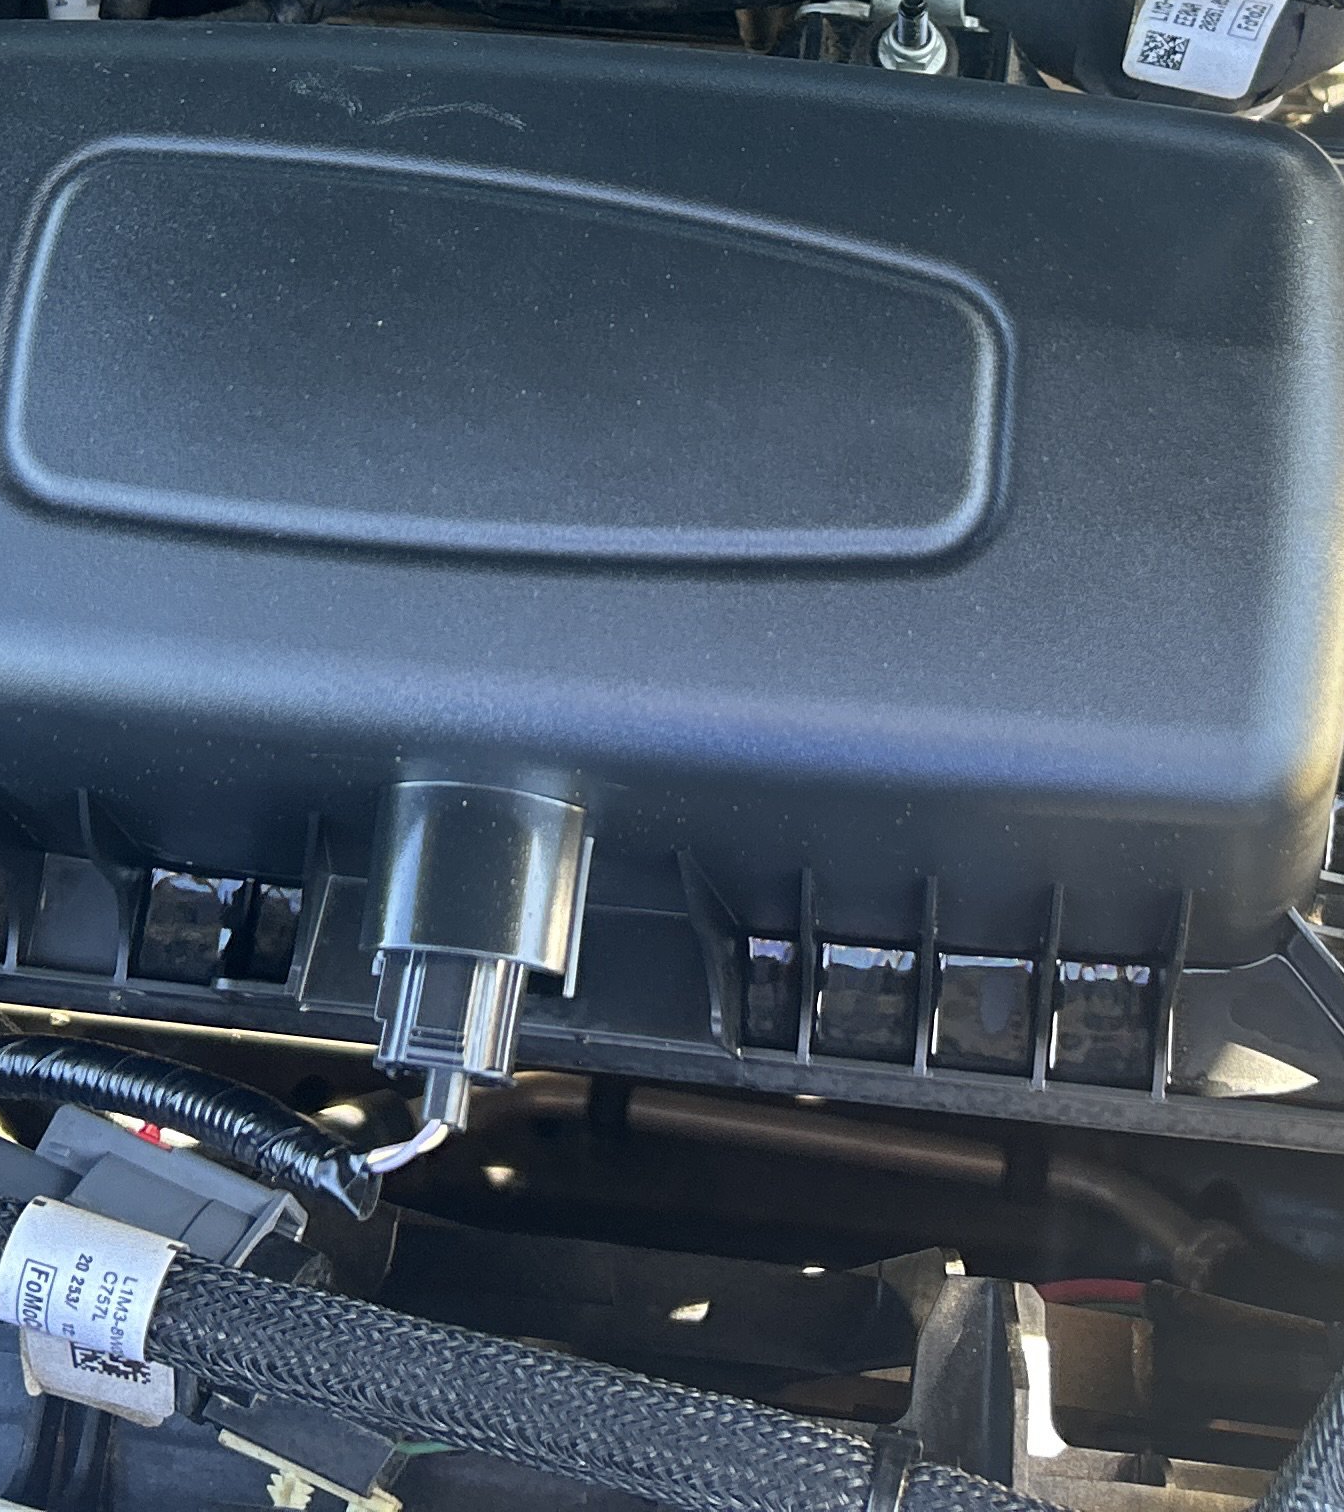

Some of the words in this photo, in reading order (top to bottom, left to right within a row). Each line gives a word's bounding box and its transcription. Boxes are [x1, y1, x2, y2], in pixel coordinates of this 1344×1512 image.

[75, 1252, 94, 1273] 20
[22, 1266, 50, 1331] FoMoC
[89, 1271, 118, 1322] C757L
